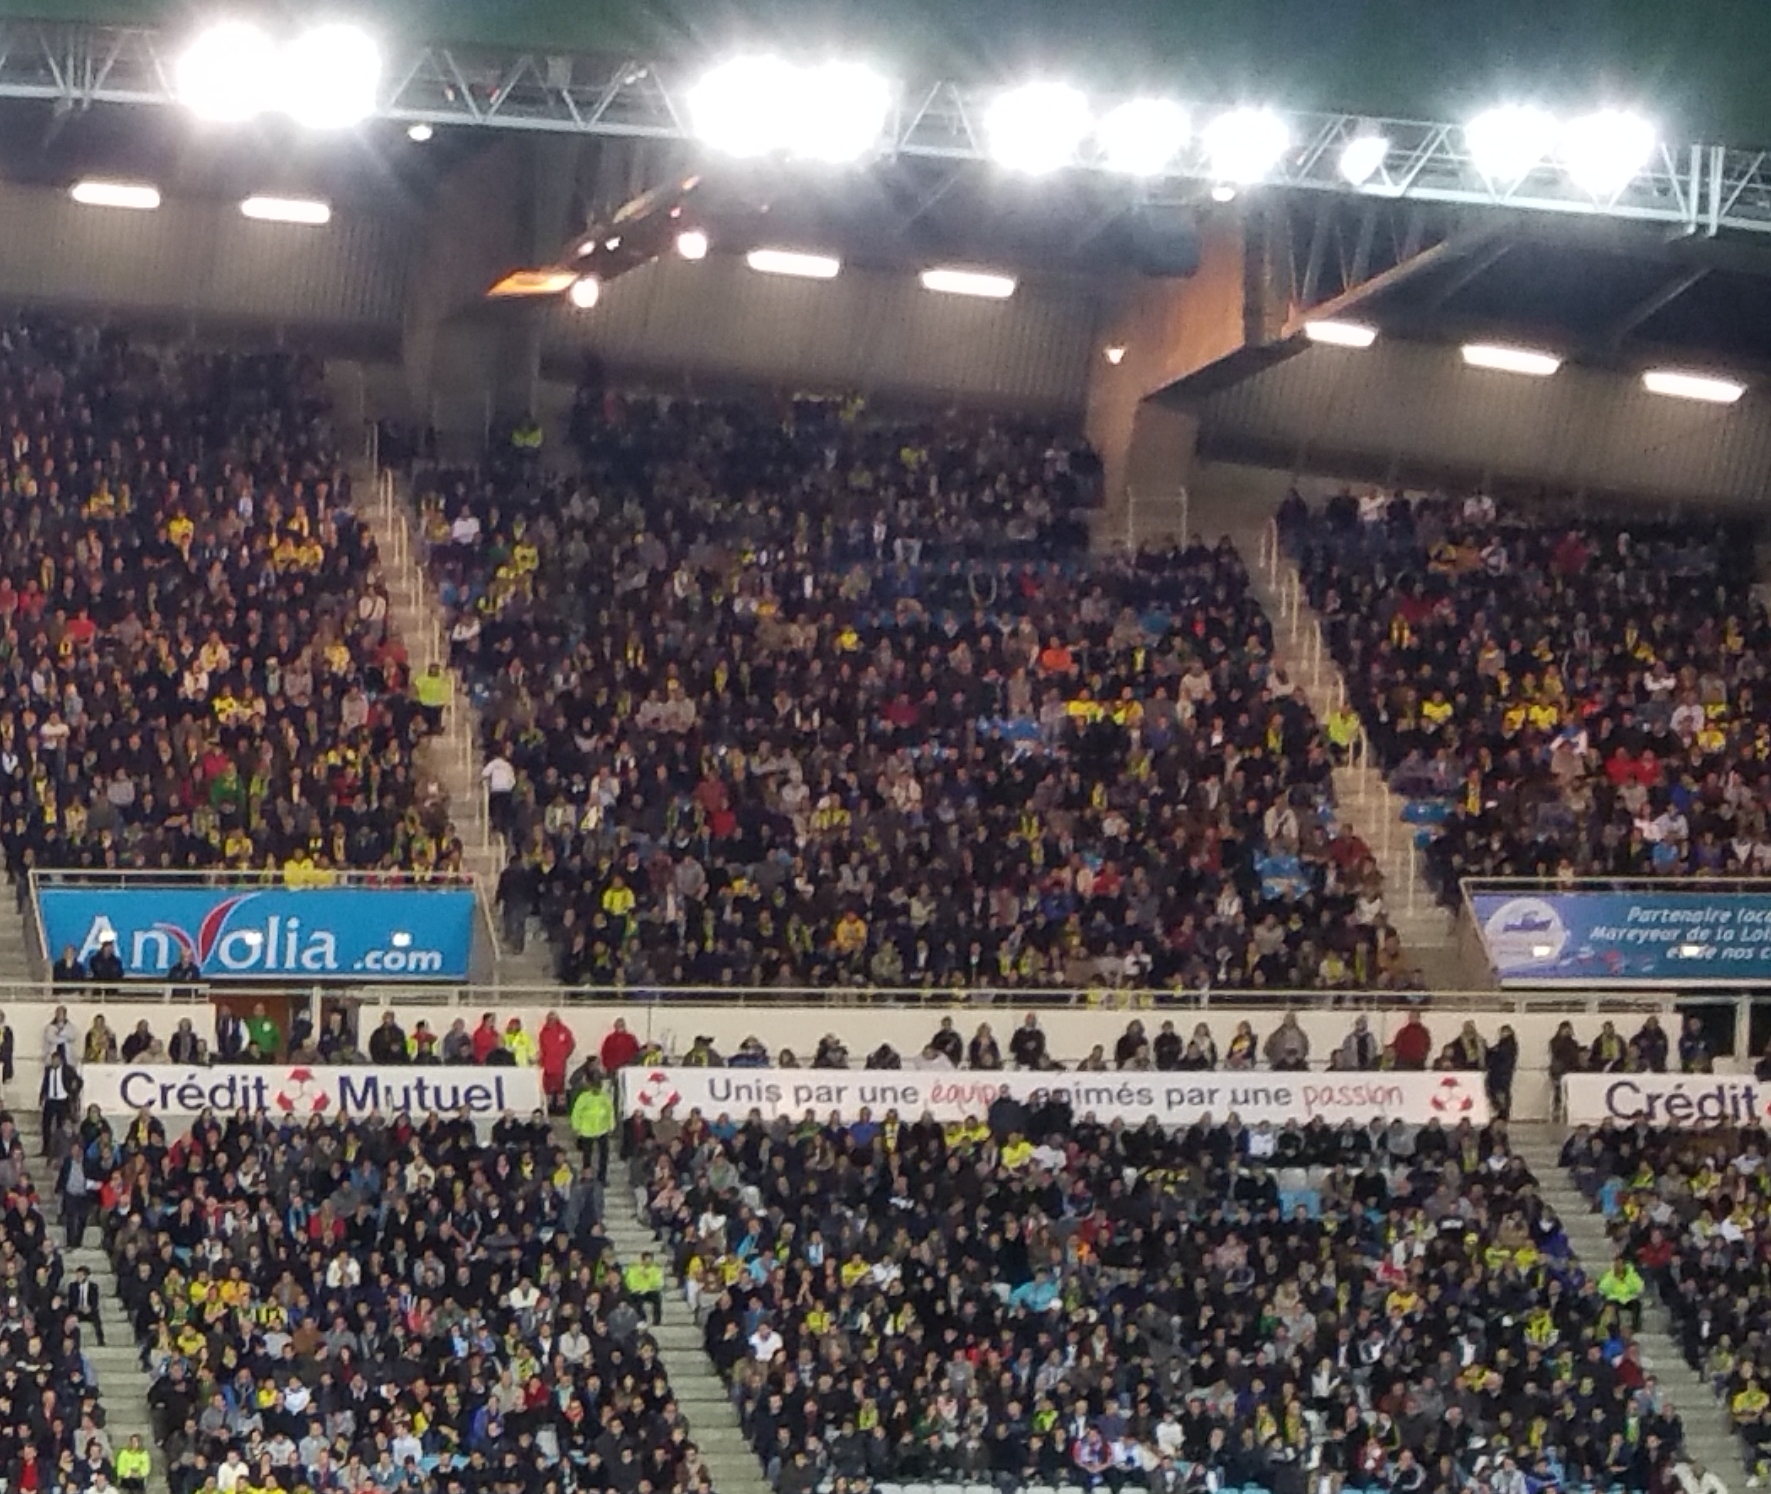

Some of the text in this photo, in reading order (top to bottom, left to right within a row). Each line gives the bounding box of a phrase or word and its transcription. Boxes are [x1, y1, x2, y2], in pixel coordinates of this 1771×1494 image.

[1686, 926, 1711, 941] de
[120, 1072, 504, 1112] Crédit Mutuel
[708, 1077, 782, 1104] Unis
[793, 1081, 849, 1106] par
[860, 1083, 919, 1105] une
[930, 1080, 1001, 1112] équip
[1166, 1086, 1220, 1113] par
[1230, 1087, 1293, 1107] une
[1303, 1085, 1404, 1115] passion
[1605, 1080, 1758, 1122] Crédit
